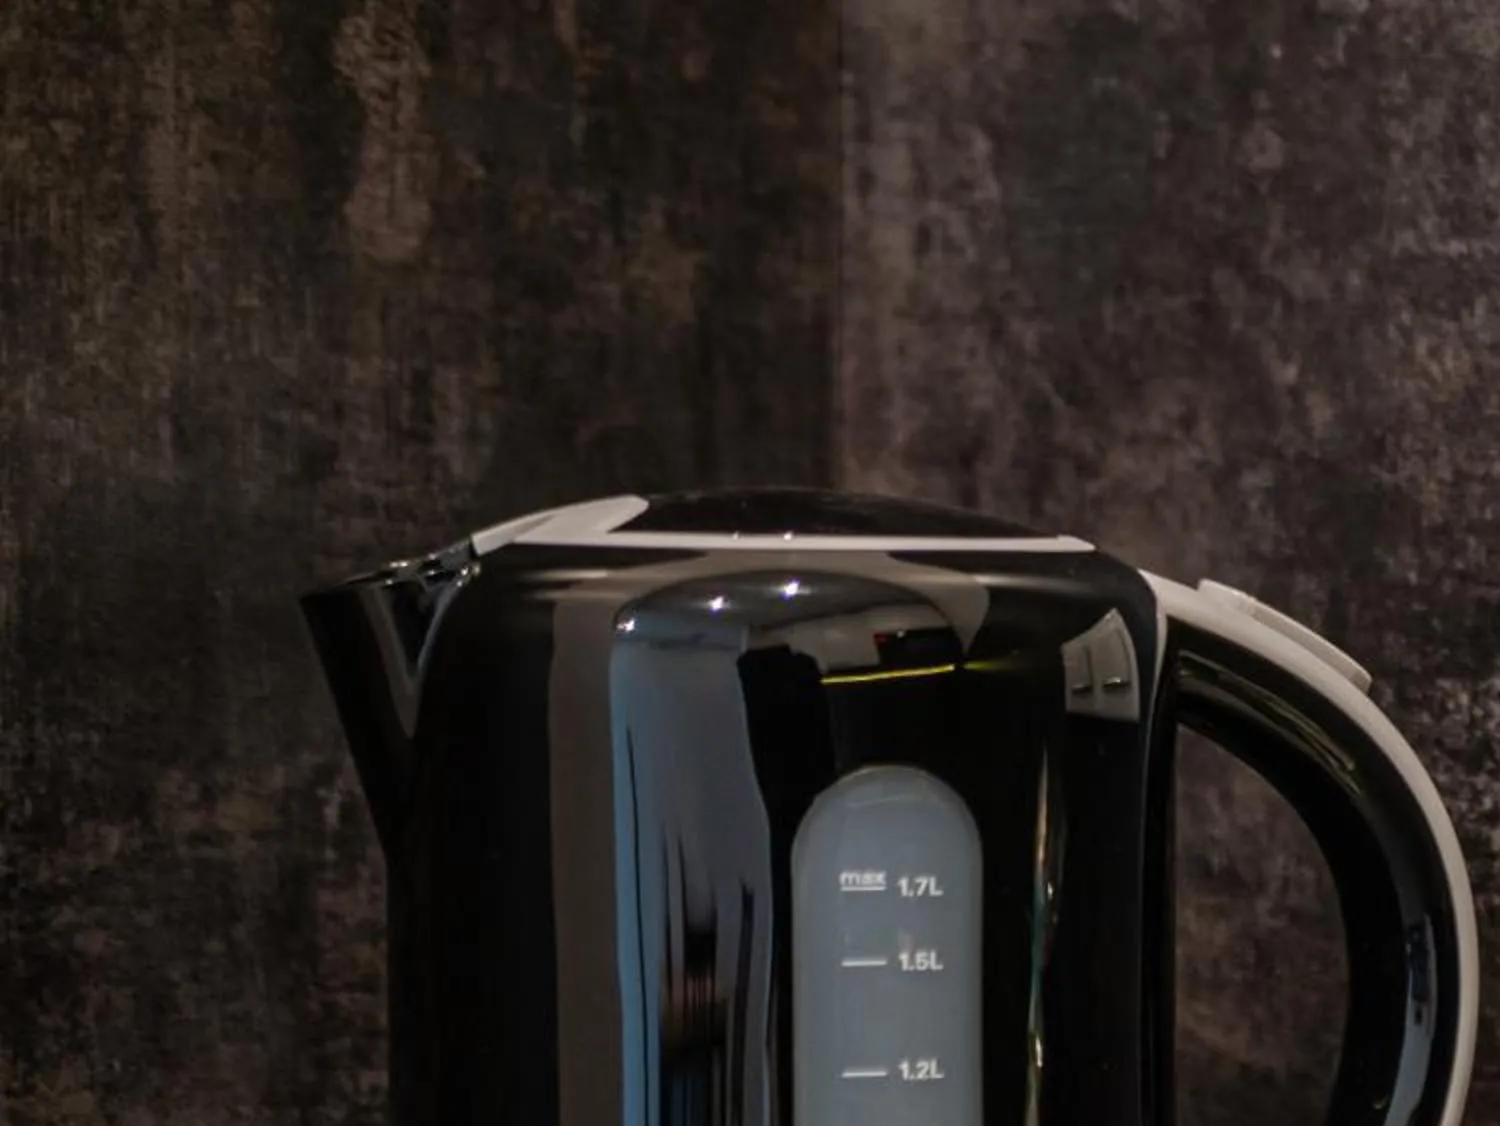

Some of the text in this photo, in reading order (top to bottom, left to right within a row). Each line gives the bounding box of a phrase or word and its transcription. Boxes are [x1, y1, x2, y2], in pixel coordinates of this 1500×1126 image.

[840, 870, 944, 897] max 1.7L
[899, 950, 944, 972] 1.5L
[899, 1057, 945, 1081] 1.2L
